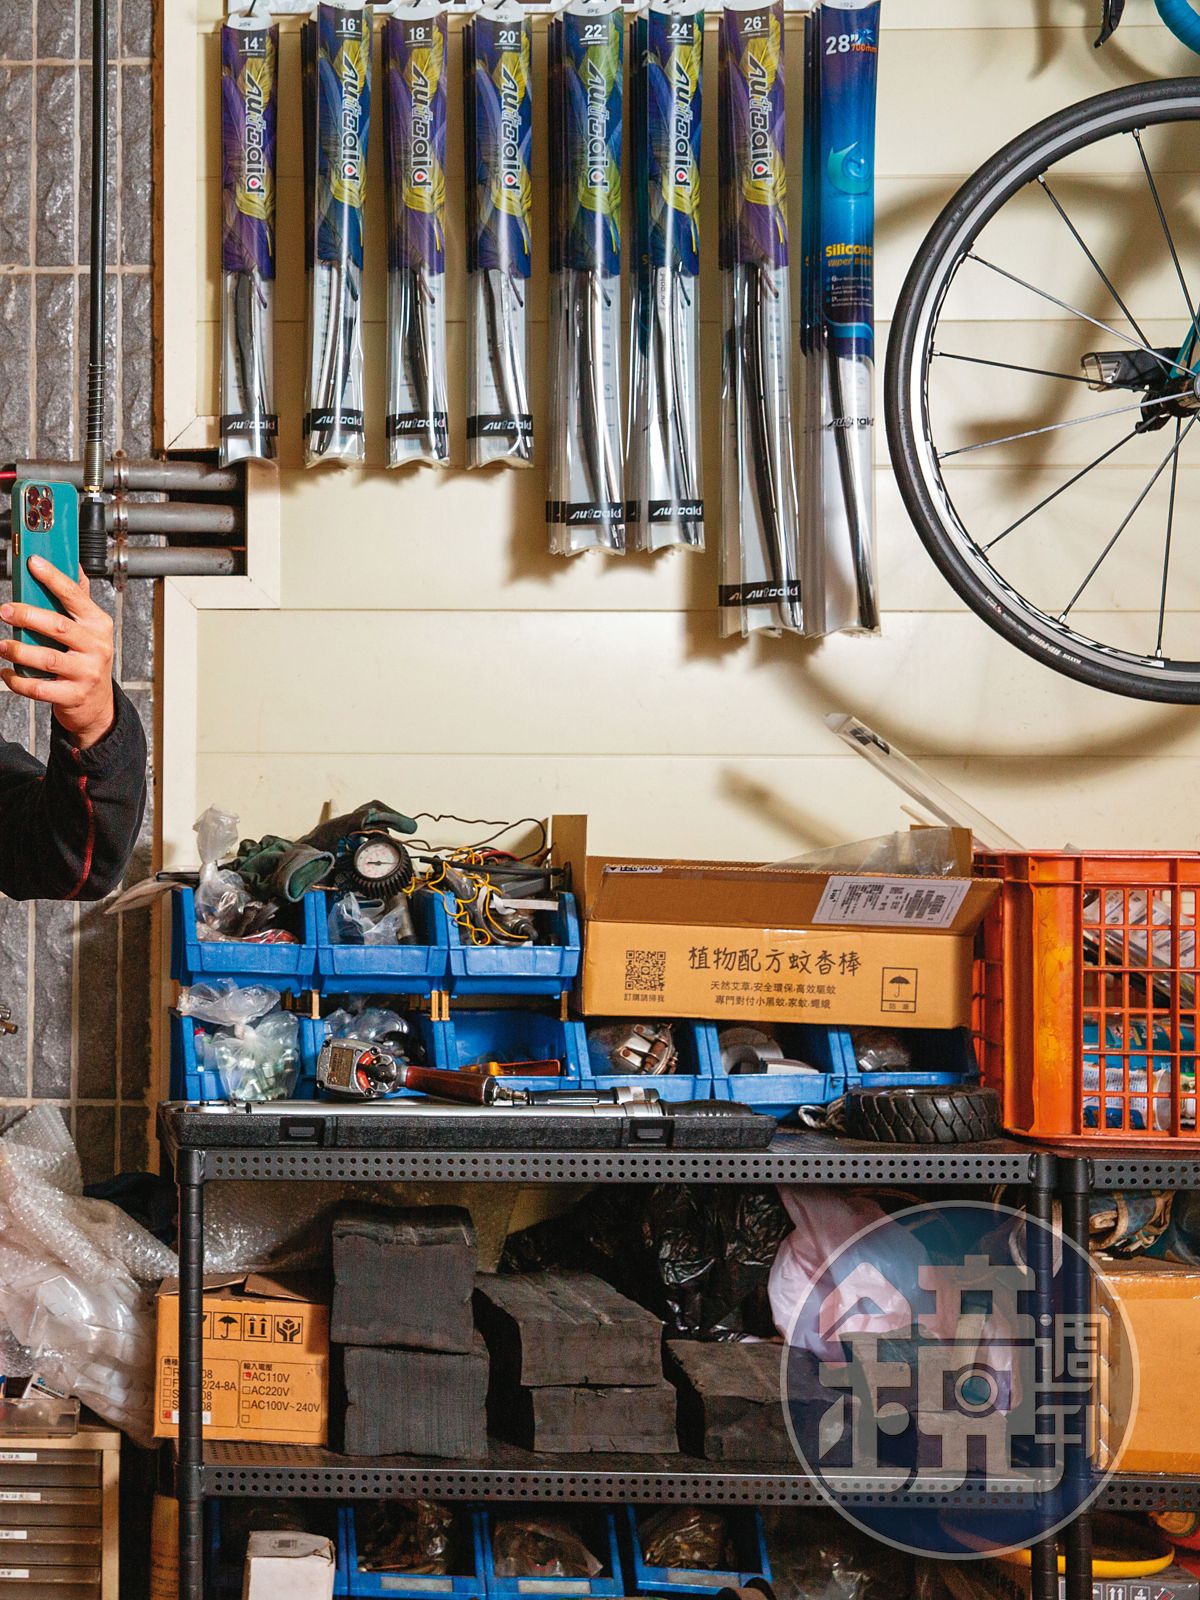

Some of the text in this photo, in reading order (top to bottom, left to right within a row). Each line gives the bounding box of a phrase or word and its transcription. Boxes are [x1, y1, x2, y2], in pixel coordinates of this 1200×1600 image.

[688, 946, 862, 977] 植物配方蚊香棒
[251, 1372, 290, 1383] AC110V
[251, 1386, 290, 1396] AC220V
